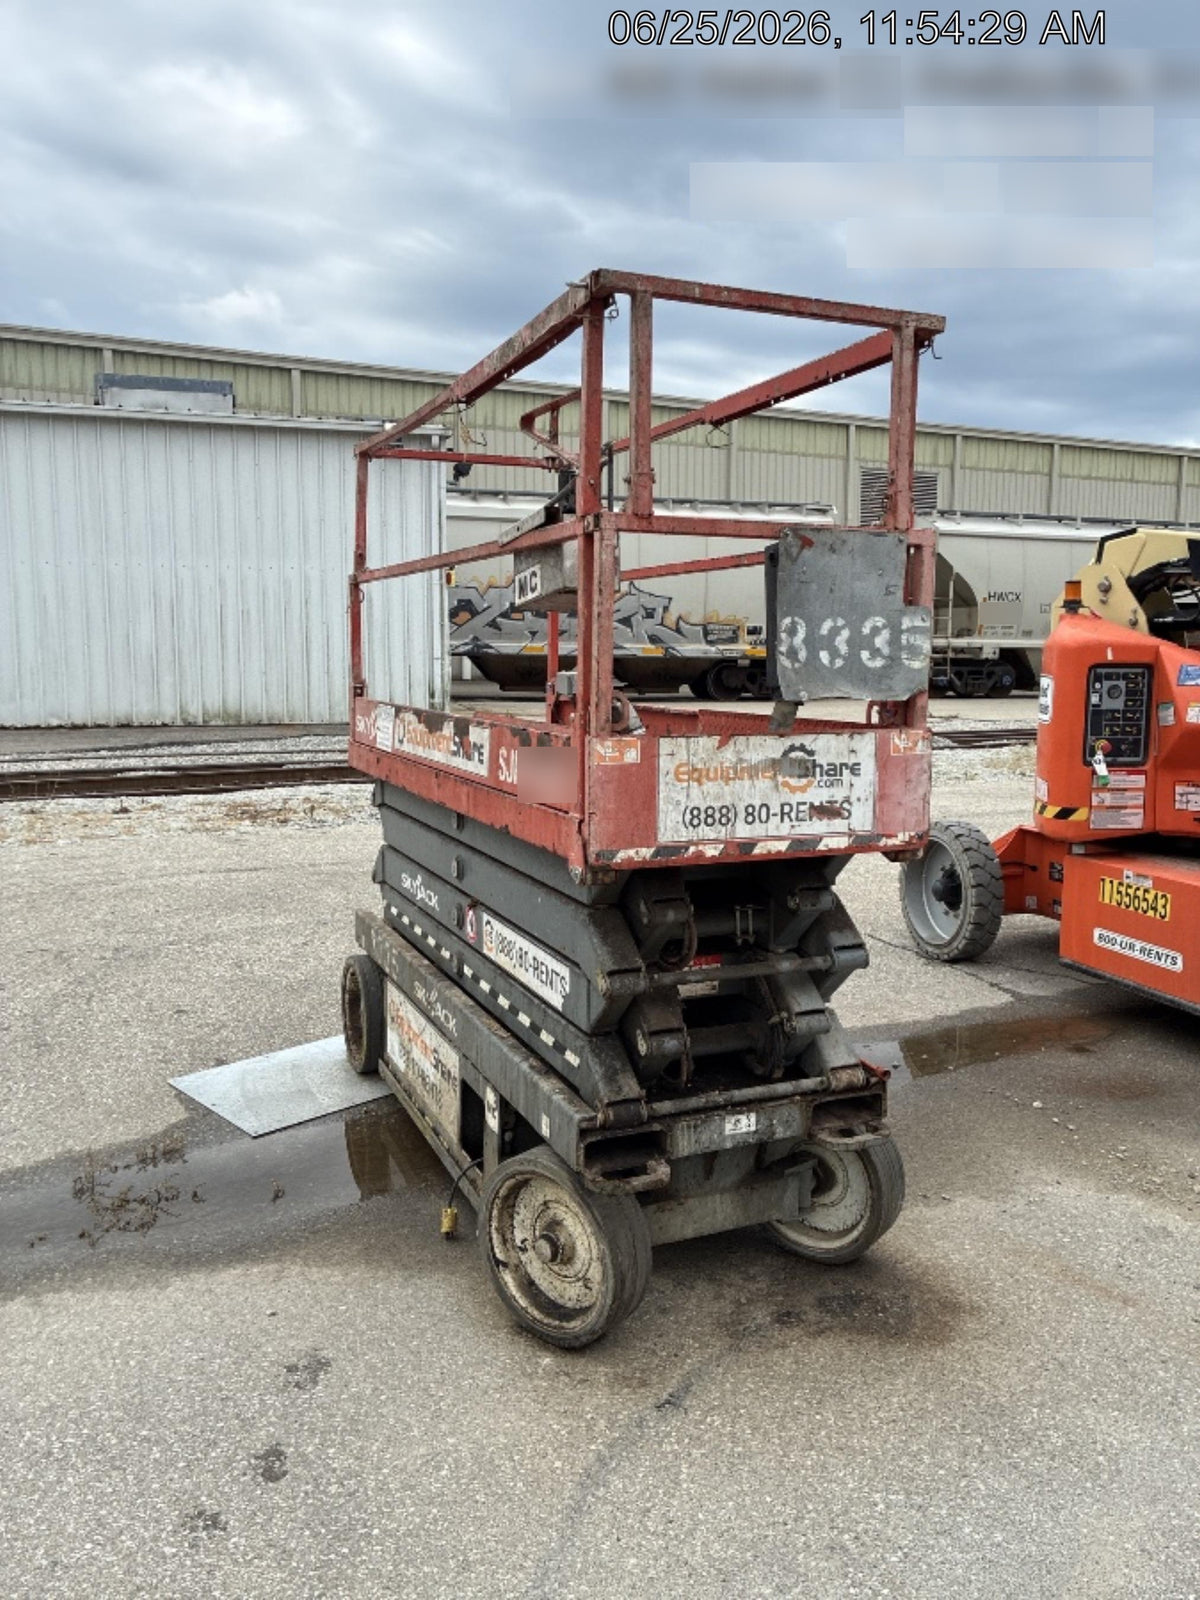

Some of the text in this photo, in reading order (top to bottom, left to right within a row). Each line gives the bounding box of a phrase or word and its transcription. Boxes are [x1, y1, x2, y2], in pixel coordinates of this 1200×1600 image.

[988, 591, 1021, 602] HWCX
[674, 759, 861, 785] Equipmehare
[682, 803, 738, 829] (888)
[1100, 877, 1169, 920] 11556543
[1097, 931, 1178, 967] 800-UR-RENTS
